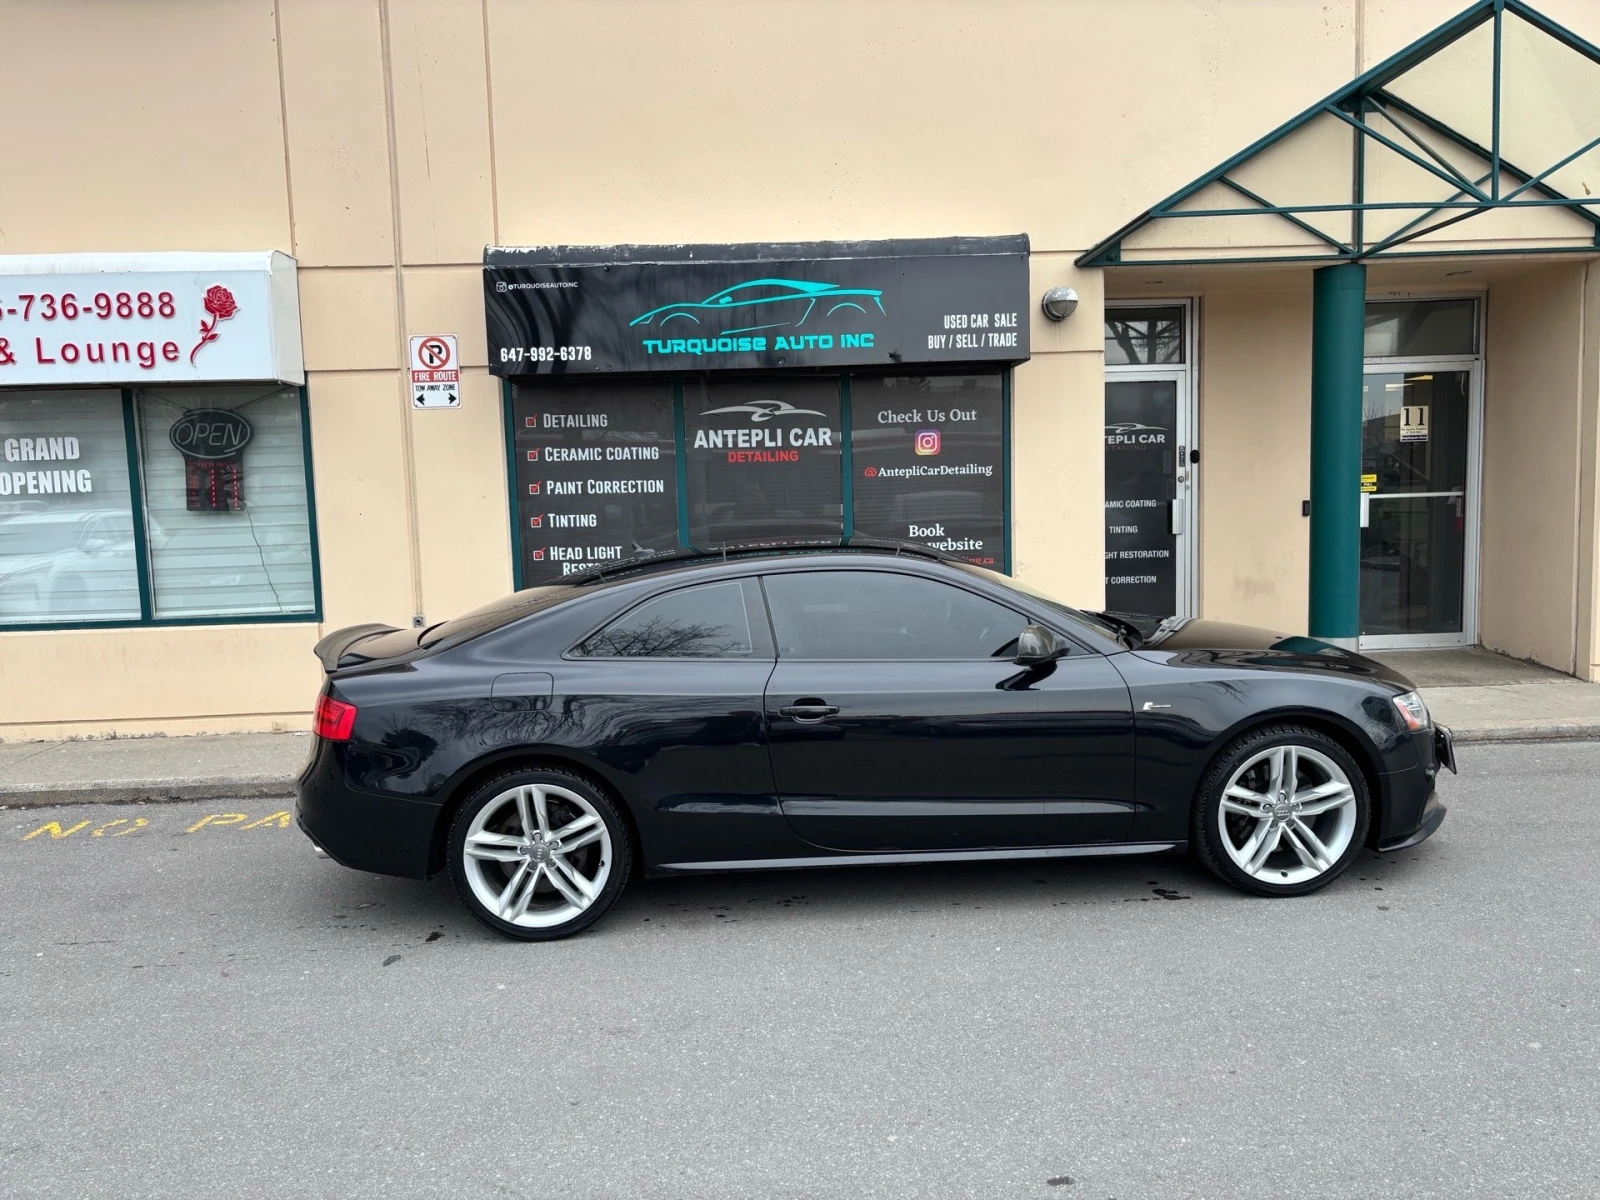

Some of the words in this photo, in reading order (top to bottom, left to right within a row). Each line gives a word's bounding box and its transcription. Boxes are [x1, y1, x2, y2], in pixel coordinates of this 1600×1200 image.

[508, 282, 578, 290] @TURQUOISEAUTOINC
[0, 292, 175, 321] -736-9888
[944, 314, 967, 329] USED
[971, 313, 989, 328] CAR
[994, 313, 1017, 328] SALE
[643, 337, 766, 355] TURQUOISE
[774, 334, 833, 350] AUTO
[841, 333, 874, 348] INC
[928, 335, 946, 349] BUY
[956, 334, 978, 348] SELL
[988, 333, 1017, 348] TRADE
[36, 337, 180, 370] Lounge
[500, 346, 592, 362] 647-992-6378
[414, 372, 430, 381] FIRE
[433, 371, 457, 381] ROUTE
[415, 384, 425, 392] TOW
[442, 383, 456, 391] ZONE
[543, 413, 608, 428] DETAILING
[878, 410, 922, 424] Check
[927, 409, 946, 422] Us
[950, 408, 977, 421] Out
[175, 423, 242, 446] OPEN
[694, 429, 782, 448] ANTEPLI
[789, 428, 832, 447] CAR
[1138, 434, 1166, 444] CAR
[5, 437, 80, 462] GRAND
[545, 447, 602, 462] CERAMIC
[606, 447, 659, 460] COATING
[728, 451, 799, 463] DETAILING
[864, 463, 993, 478] @AntepliCarDetailing
[0, 469, 92, 495] OPENING
[546, 480, 583, 494] PAINT
[587, 479, 664, 493] CORRECTION
[1125, 499, 1157, 508] COATING
[548, 513, 597, 528] TINTING
[908, 523, 945, 538] Book
[1109, 526, 1138, 534] TINTING
[550, 546, 583, 560] HEAD
[587, 546, 622, 560] LIGHT
[1119, 550, 1169, 559] RESTORATION
[1111, 576, 1157, 585] CORRECTION
